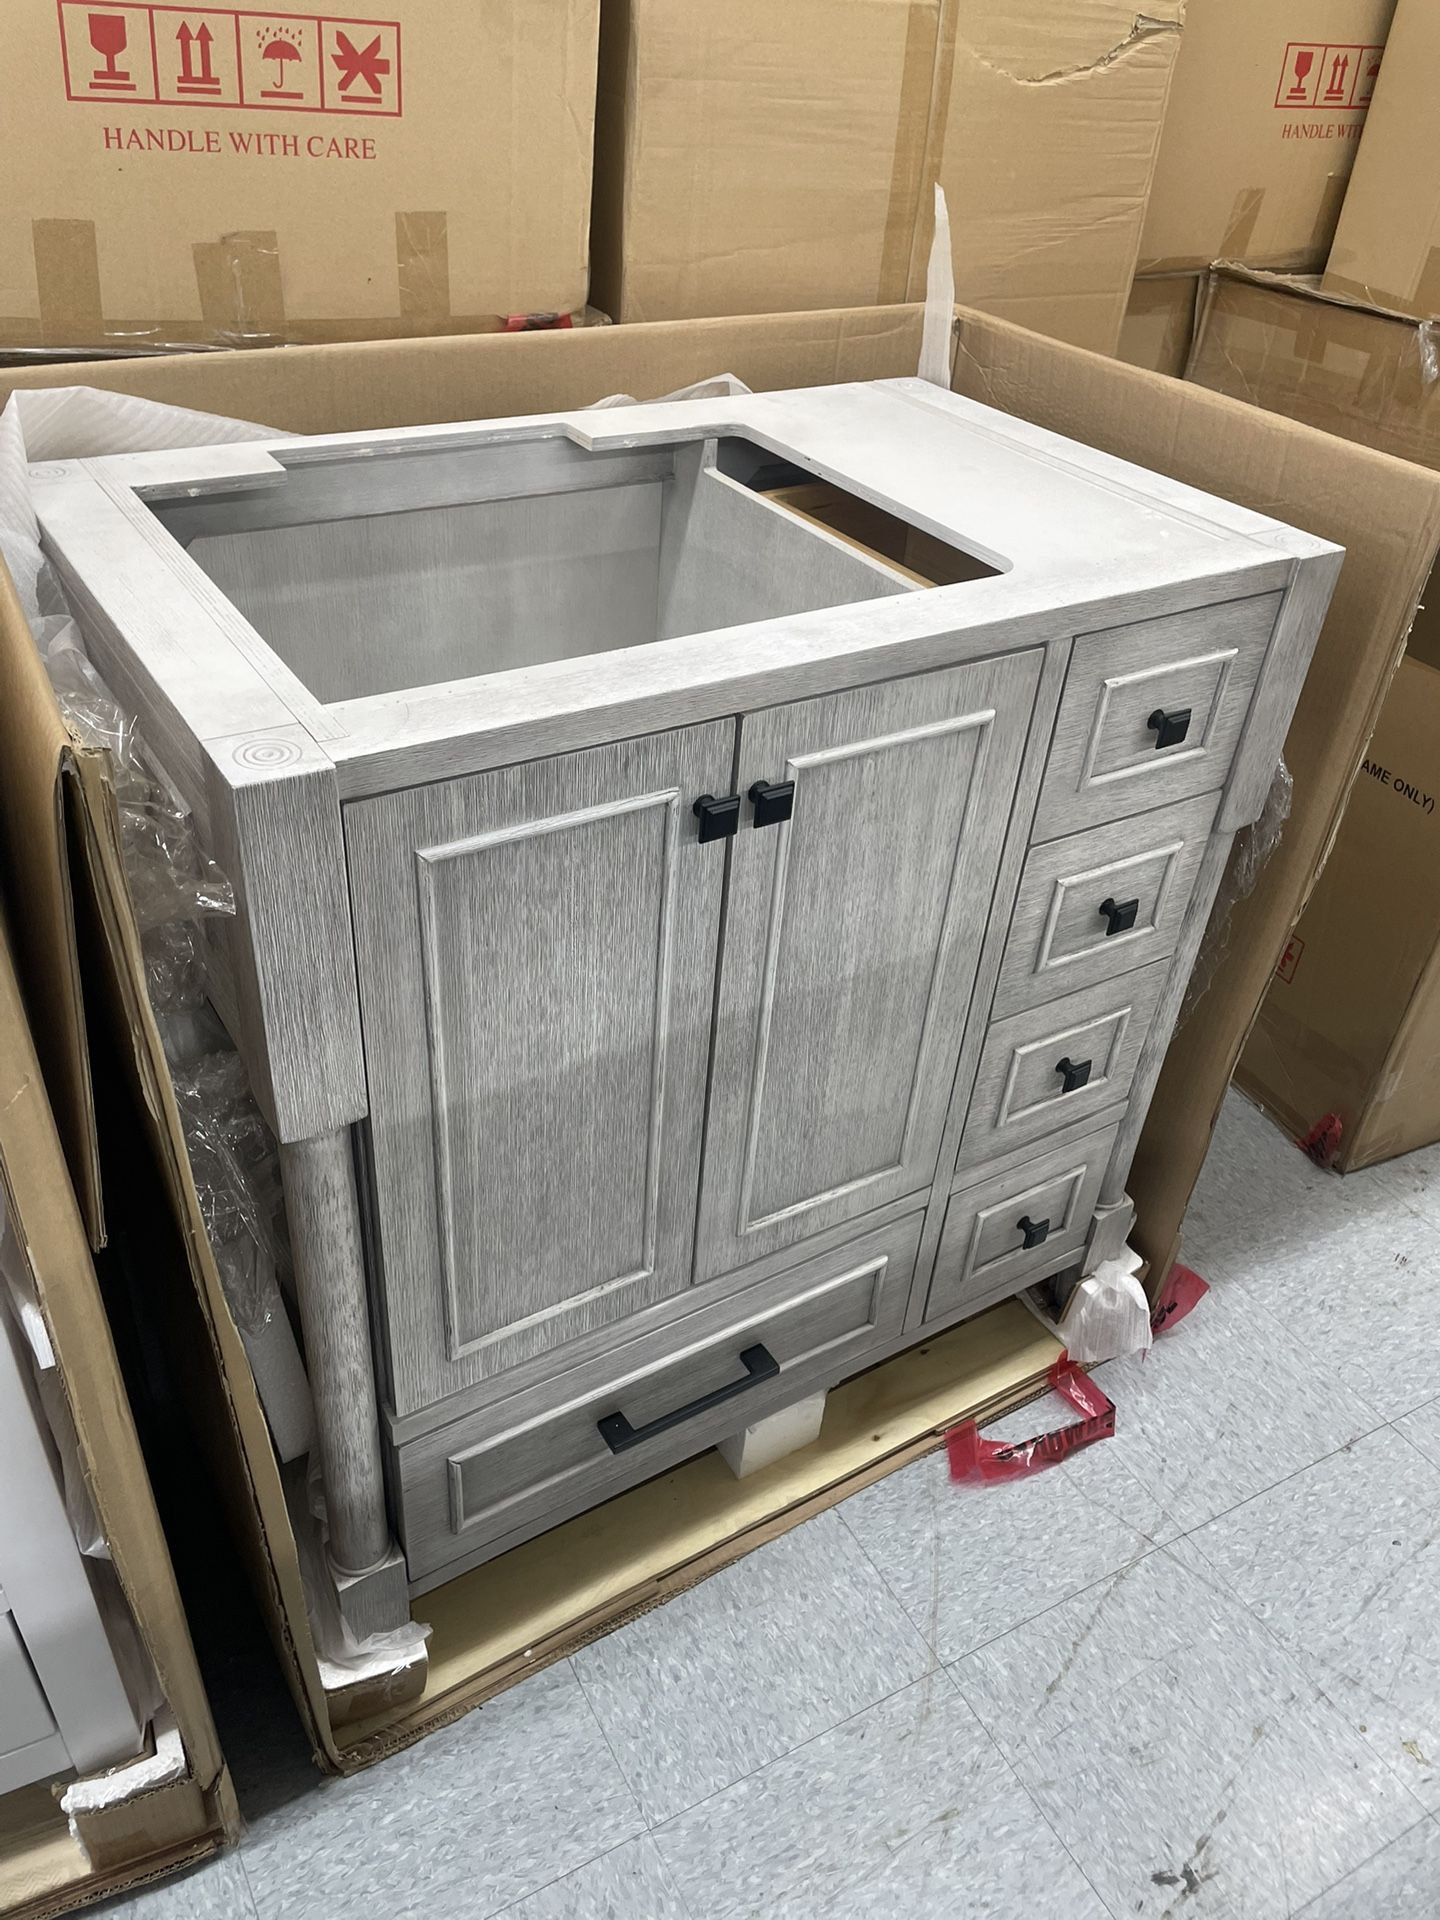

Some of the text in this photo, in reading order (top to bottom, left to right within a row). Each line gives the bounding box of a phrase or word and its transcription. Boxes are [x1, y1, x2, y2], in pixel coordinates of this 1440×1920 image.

[103, 127, 377, 159] HANDLE WITH CARE
[1282, 124, 1335, 139] HANDLE
[1393, 778, 1435, 815] ONLY)
